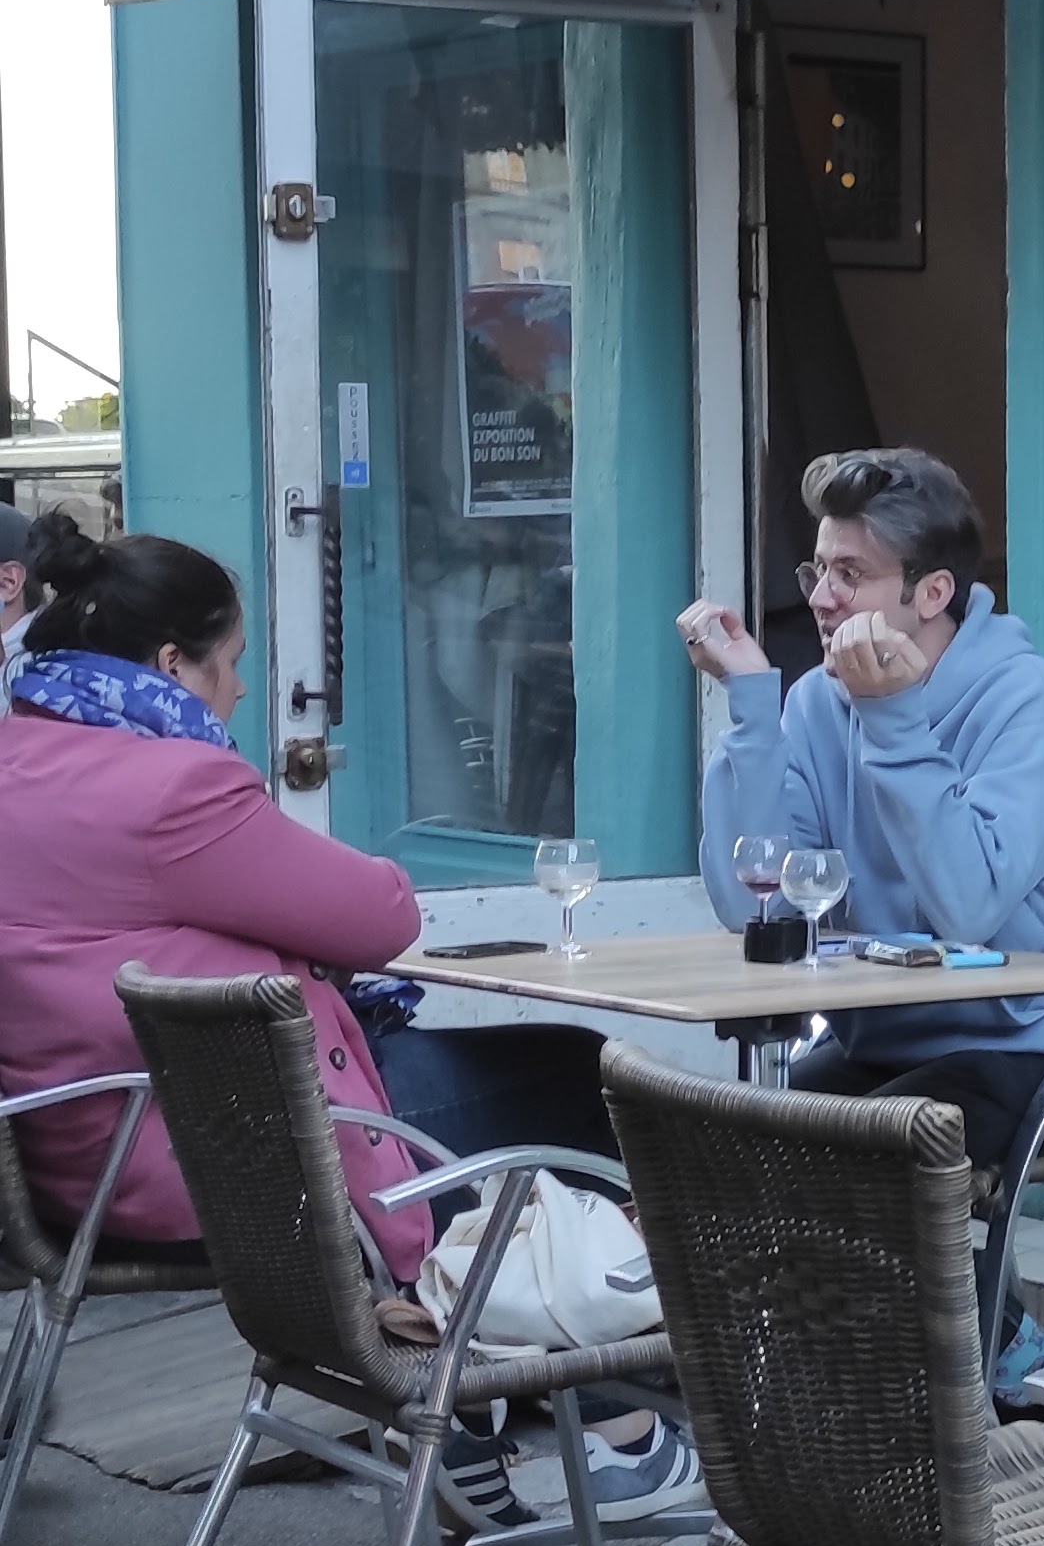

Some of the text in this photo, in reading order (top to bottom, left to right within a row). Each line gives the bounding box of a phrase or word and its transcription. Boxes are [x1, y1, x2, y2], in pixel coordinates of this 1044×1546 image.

[472, 410, 517, 427] GRAFFITI
[472, 427, 535, 445] EXPOSITION
[473, 444, 541, 462] DU BON SON
